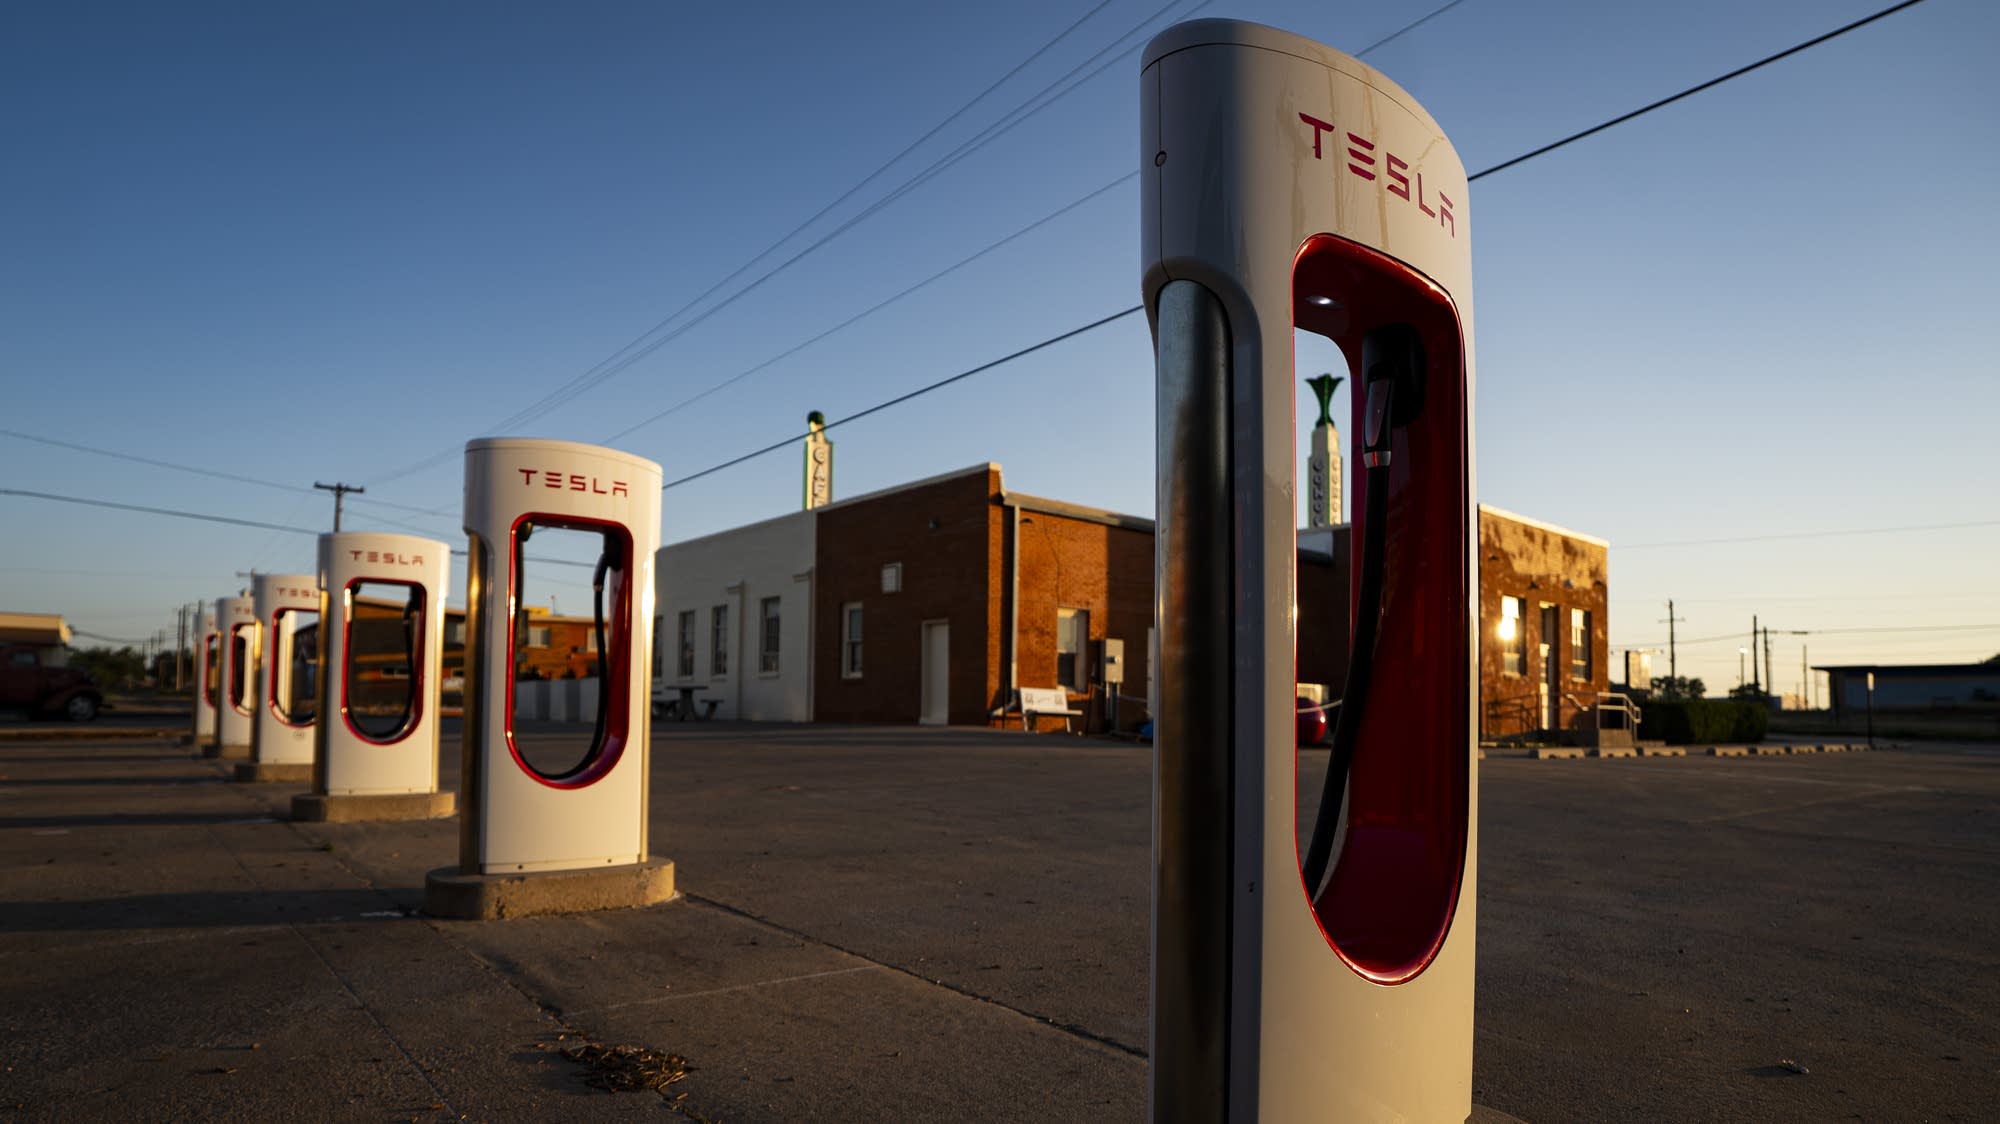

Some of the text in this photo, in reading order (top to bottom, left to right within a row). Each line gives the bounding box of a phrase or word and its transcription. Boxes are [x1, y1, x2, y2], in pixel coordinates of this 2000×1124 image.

[1298, 111, 1455, 238] TESLA
[518, 468, 628, 498] TESLA
[1312, 458, 1324, 527] CONOC
[350, 550, 424, 566] TESLA
[276, 587, 320, 599] TESL
